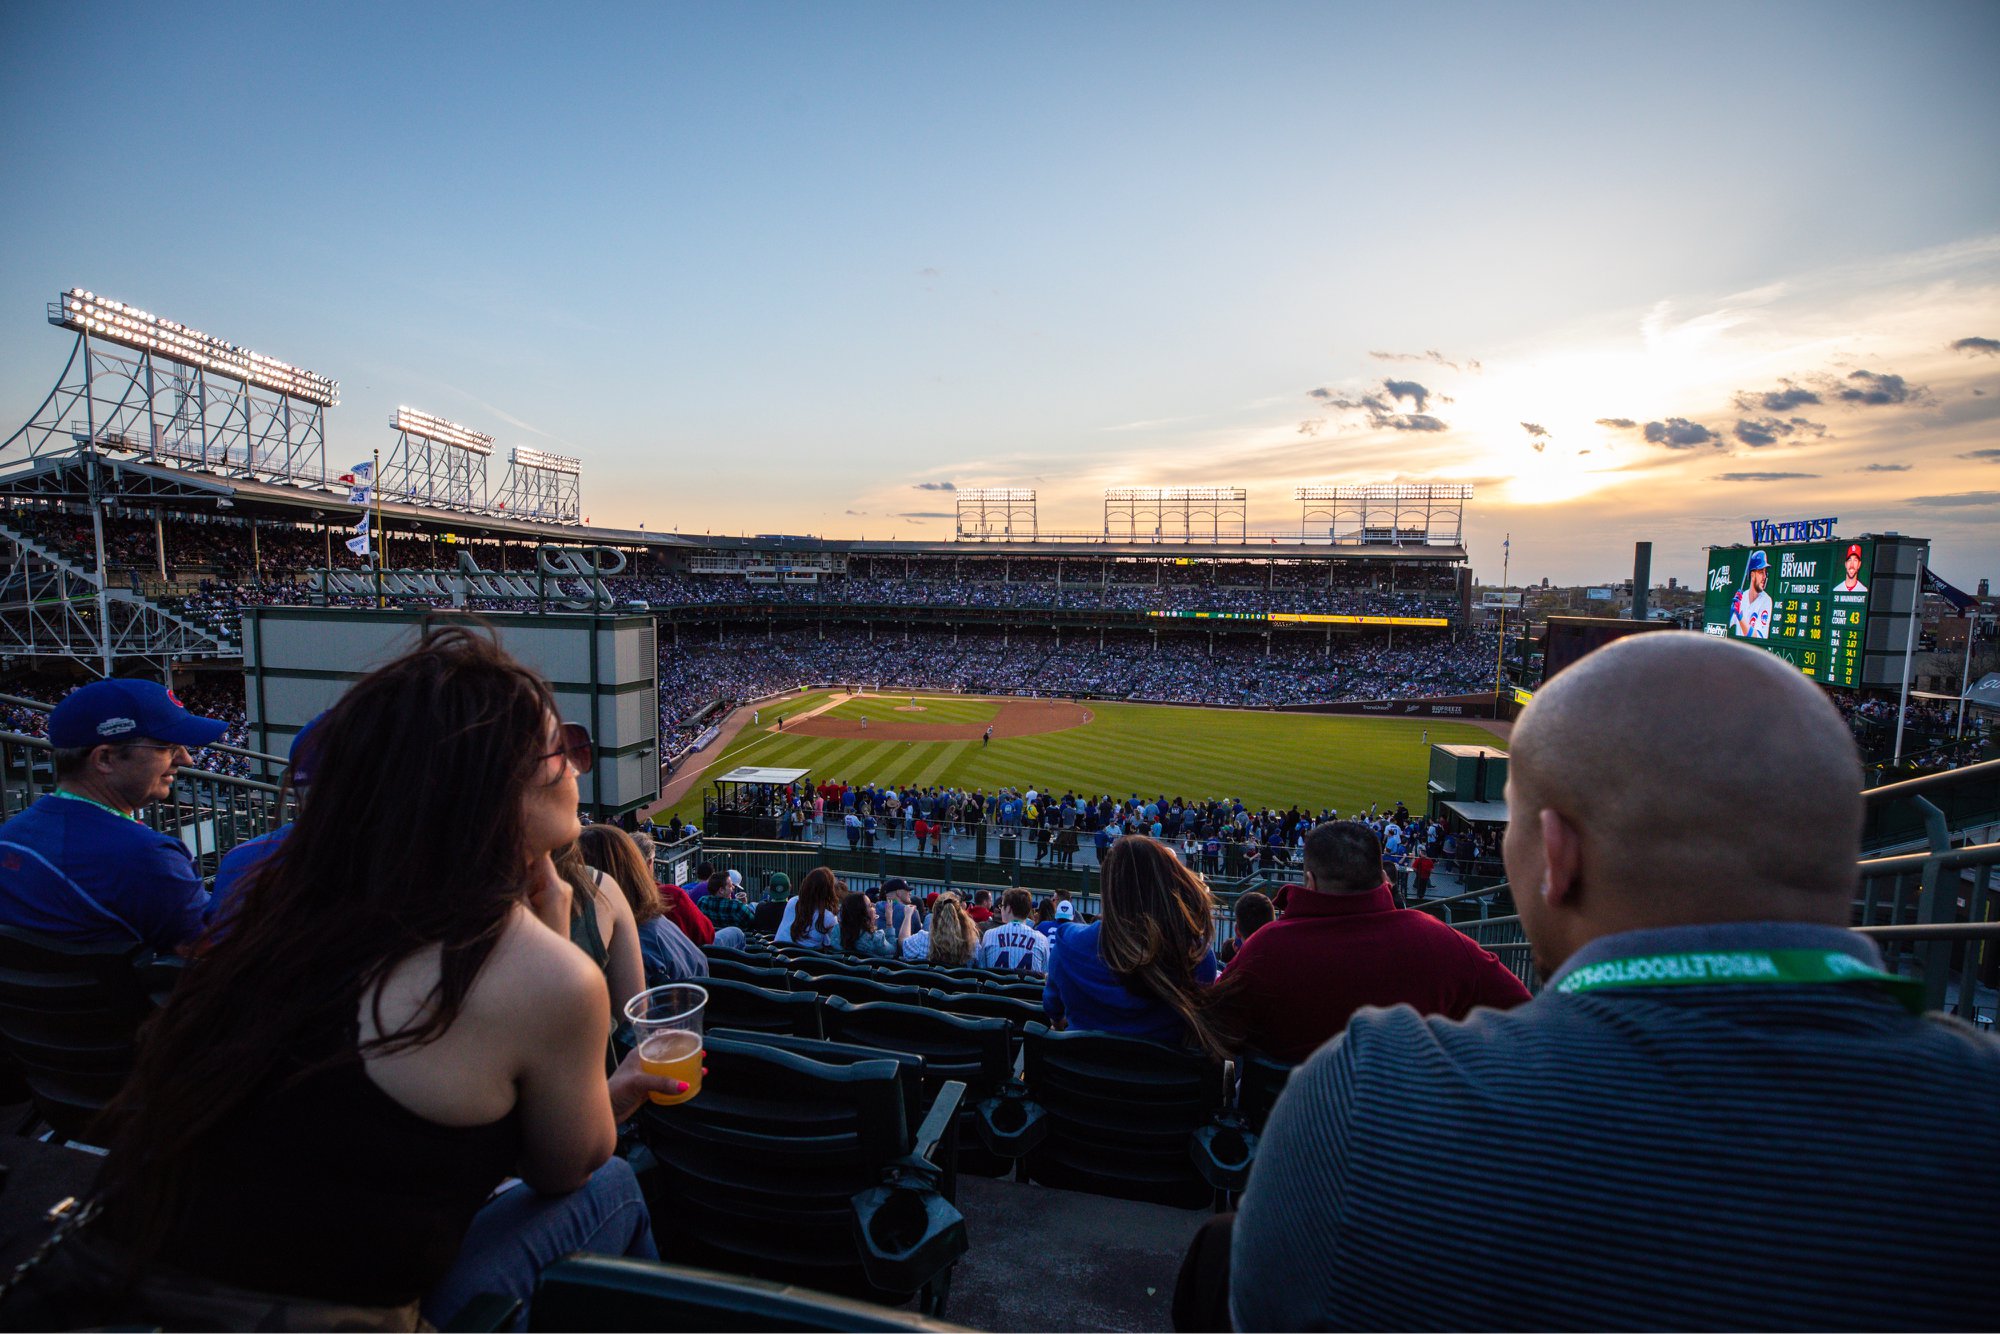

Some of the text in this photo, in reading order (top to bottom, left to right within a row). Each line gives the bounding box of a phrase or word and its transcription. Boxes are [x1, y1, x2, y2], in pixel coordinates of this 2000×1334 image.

[1782, 553, 1796, 563] KRIS
[1780, 562, 1817, 578] BRYANT
[1780, 582, 1820, 594] 17 THIRD BASE
[1840, 595, 1866, 603] WAINWRIGHT
[1774, 601, 1798, 611] AVG .231
[1801, 601, 1821, 612] HR 3
[1773, 613, 1782, 622] OBP
[1833, 609, 1846, 618] PITCH
[1849, 611, 1860, 625] 43
[1800, 614, 1821, 626] RBI 15
[1832, 617, 1847, 625] COUNT
[1705, 625, 1727, 638] Hefty
[1772, 626, 1796, 637] SLG .417
[1798, 629, 1805, 637] AB
[1804, 652, 1816, 665] 90
[998, 933, 1036, 951] RIZZO
